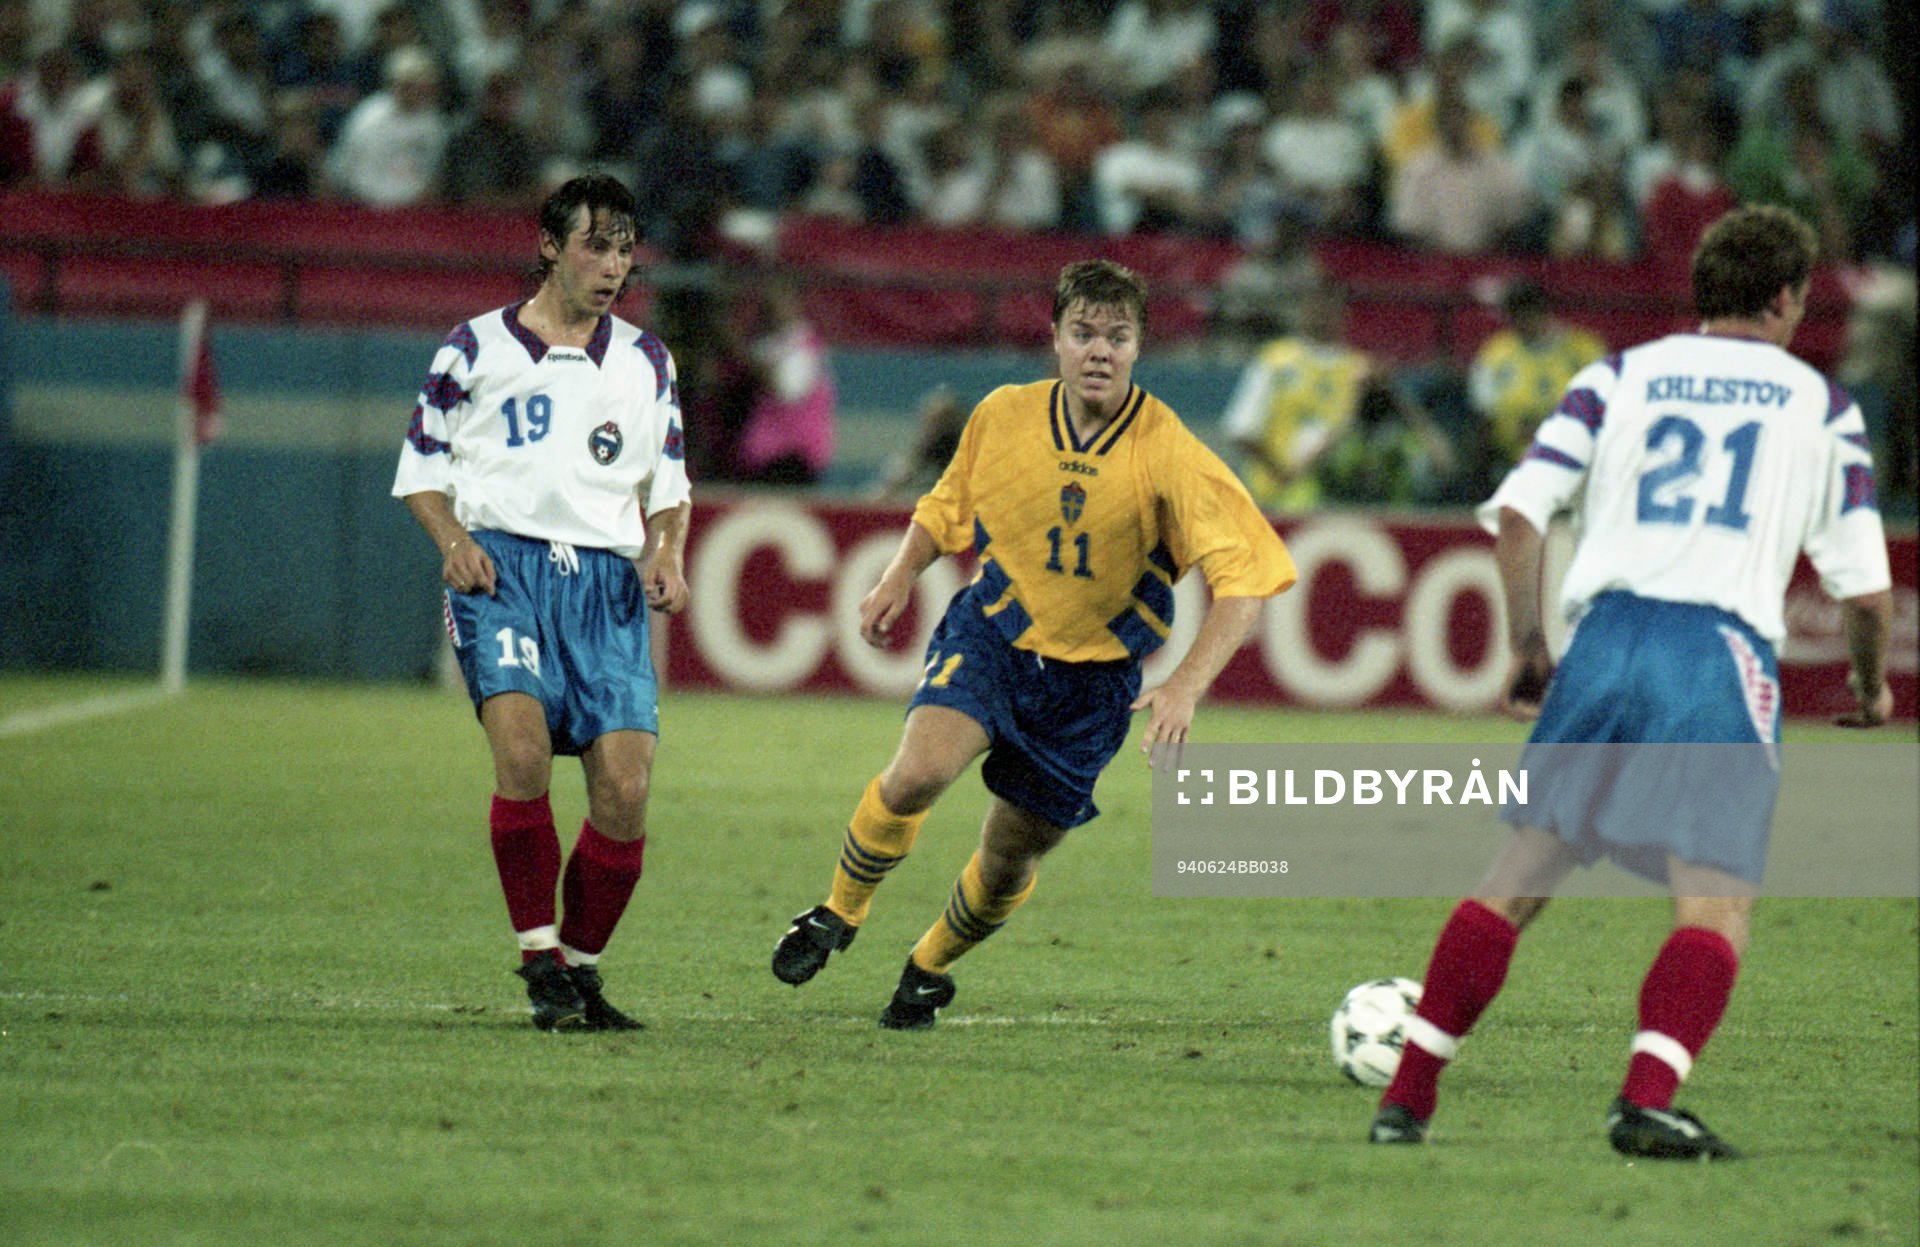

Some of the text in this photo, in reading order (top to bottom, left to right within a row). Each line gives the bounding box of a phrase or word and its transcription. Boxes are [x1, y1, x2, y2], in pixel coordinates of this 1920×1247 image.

[547, 353, 587, 362] Reebok
[1646, 375, 1792, 408] KHLESTOV
[500, 393, 553, 448] 19
[1058, 460, 1098, 477] adidas
[1637, 414, 1764, 531] 21
[1045, 526, 1095, 579] 11
[495, 627, 542, 679] 19
